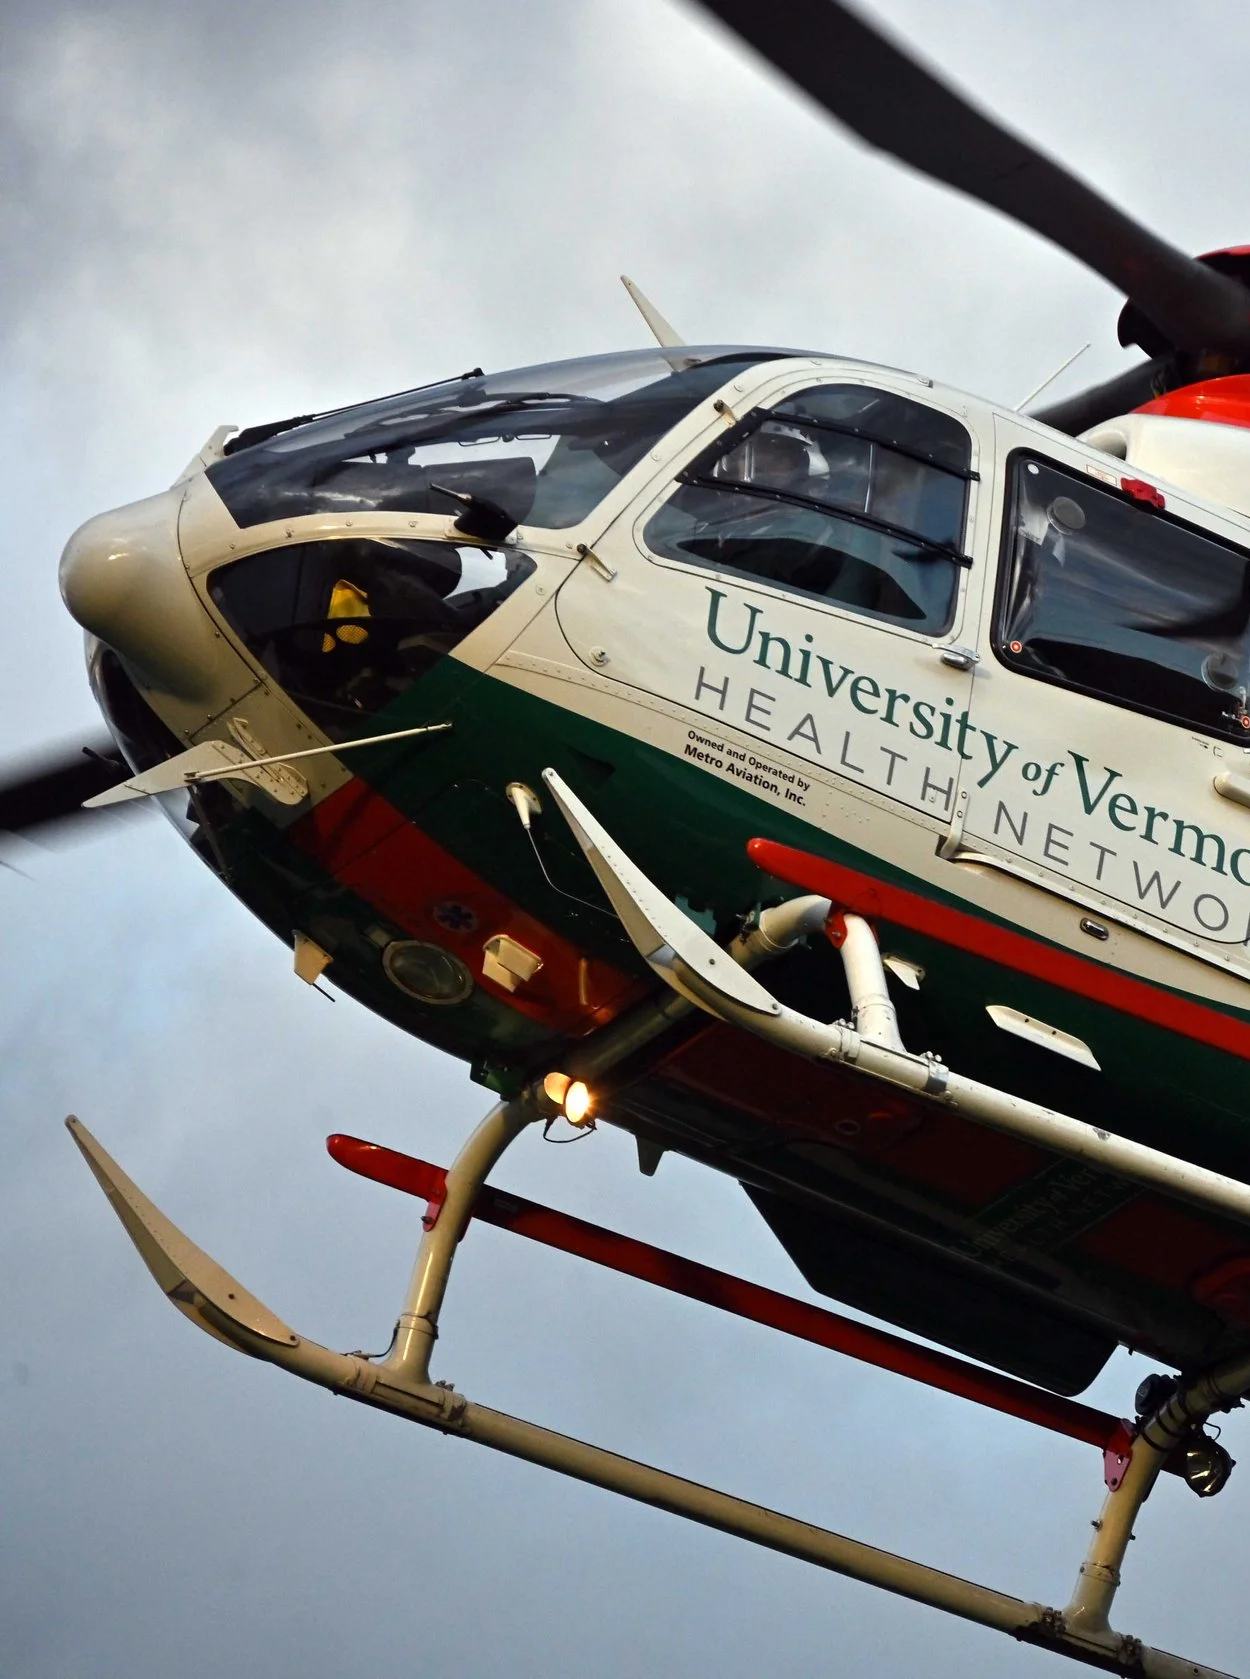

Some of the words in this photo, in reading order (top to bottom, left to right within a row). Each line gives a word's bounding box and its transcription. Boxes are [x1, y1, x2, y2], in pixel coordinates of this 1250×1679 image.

[694, 666, 955, 814] HEALTH
[705, 586, 1019, 788] University
[1021, 758, 1066, 796] of
[684, 744, 723, 769] Metro
[725, 762, 781, 796] Aviation,
[785, 788, 806, 806] Inc.
[687, 730, 725, 753] Owned
[726, 747, 747, 762] and
[748, 756, 795, 783] Operated
[797, 777, 811, 792] by
